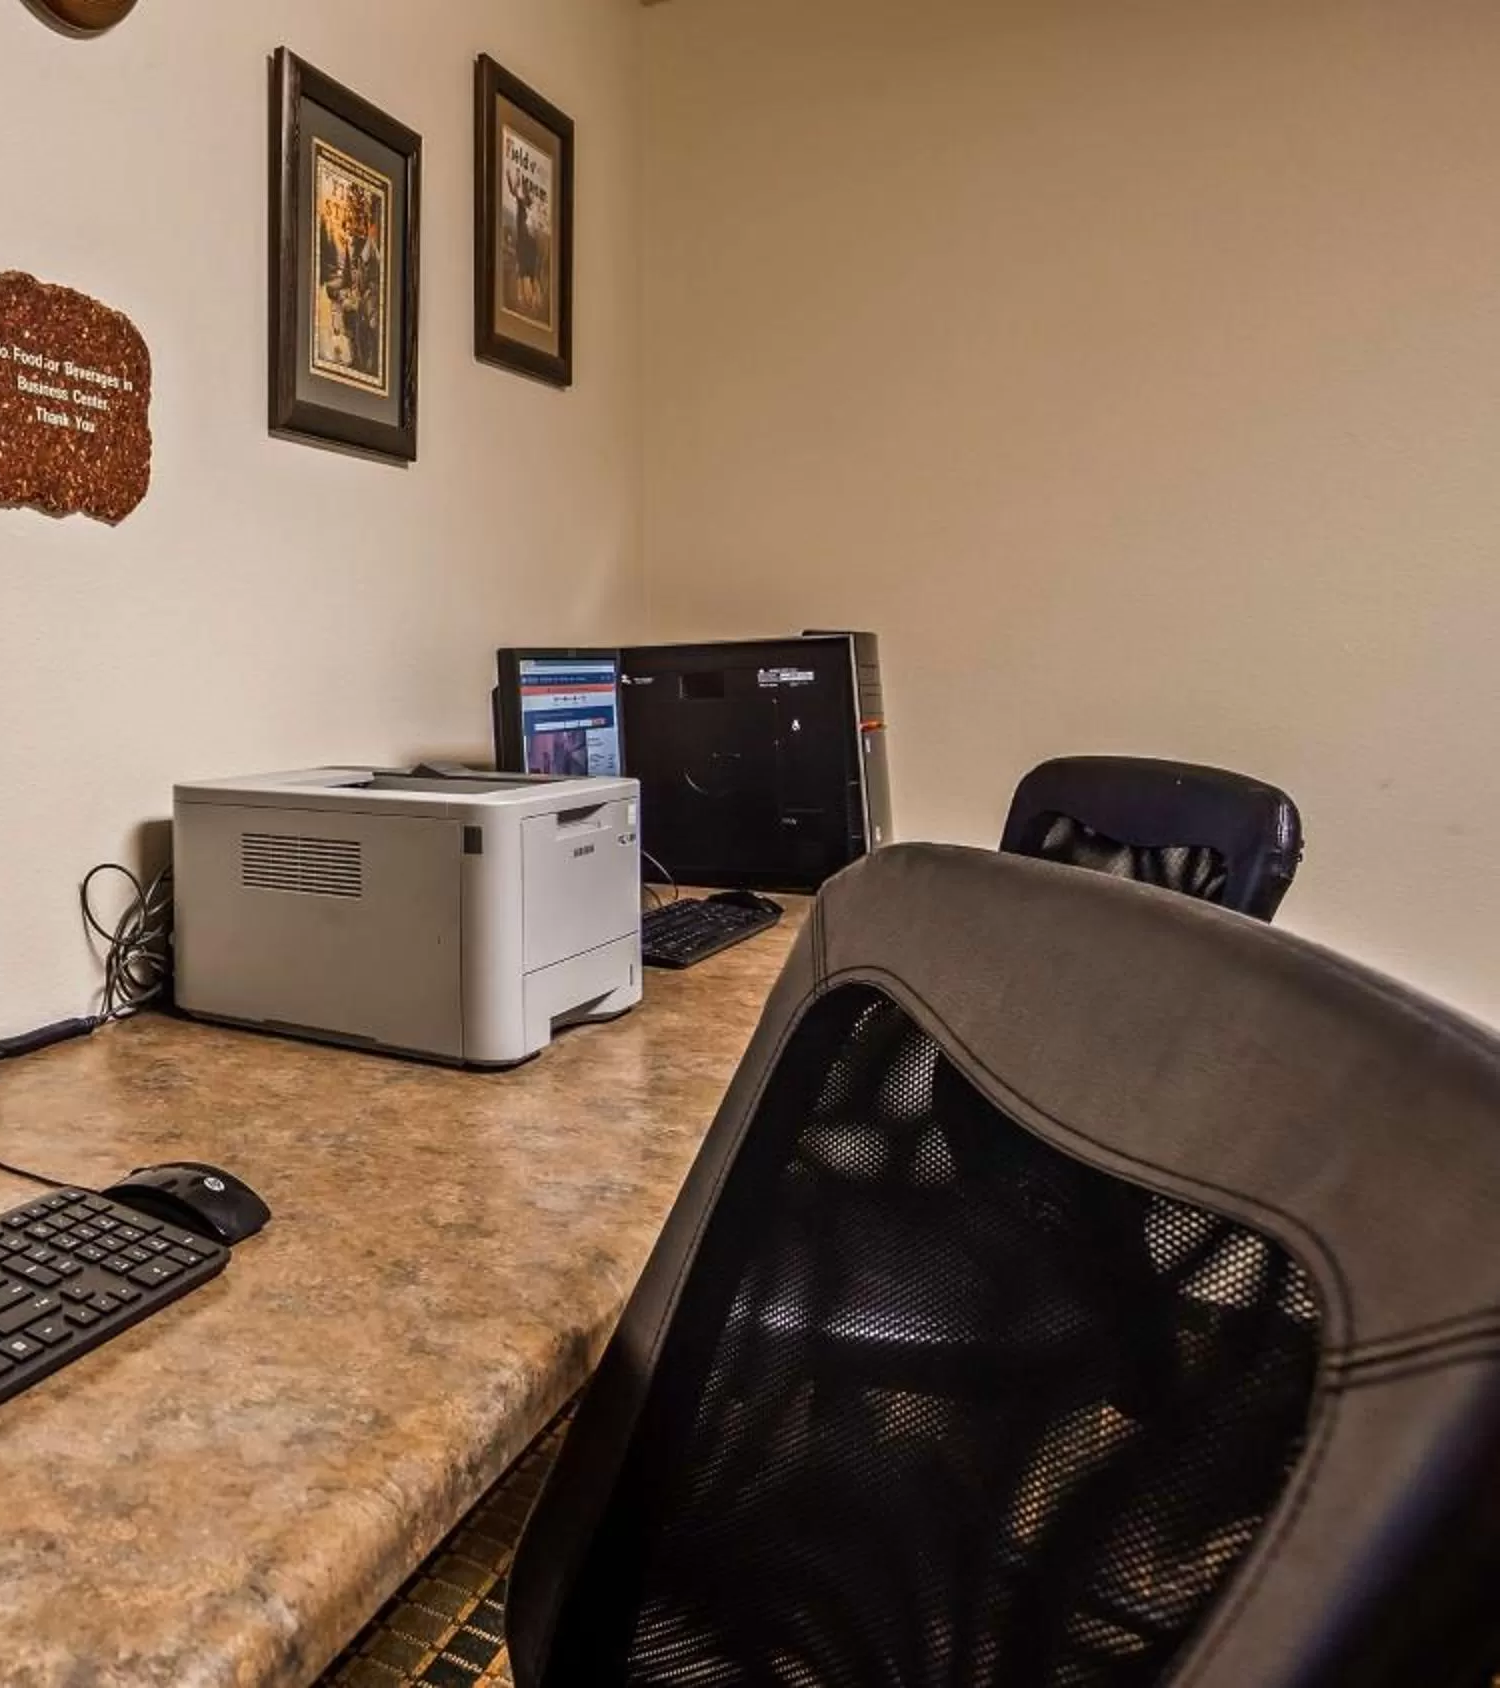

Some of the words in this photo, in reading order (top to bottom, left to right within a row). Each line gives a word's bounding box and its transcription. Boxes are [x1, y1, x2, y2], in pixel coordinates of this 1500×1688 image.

[13, 344, 43, 368] Food
[47, 360, 59, 373] or
[63, 361, 120, 389] Beverages
[17, 375, 69, 400] Business
[36, 405, 69, 426] Thank
[75, 414, 96, 433] You
